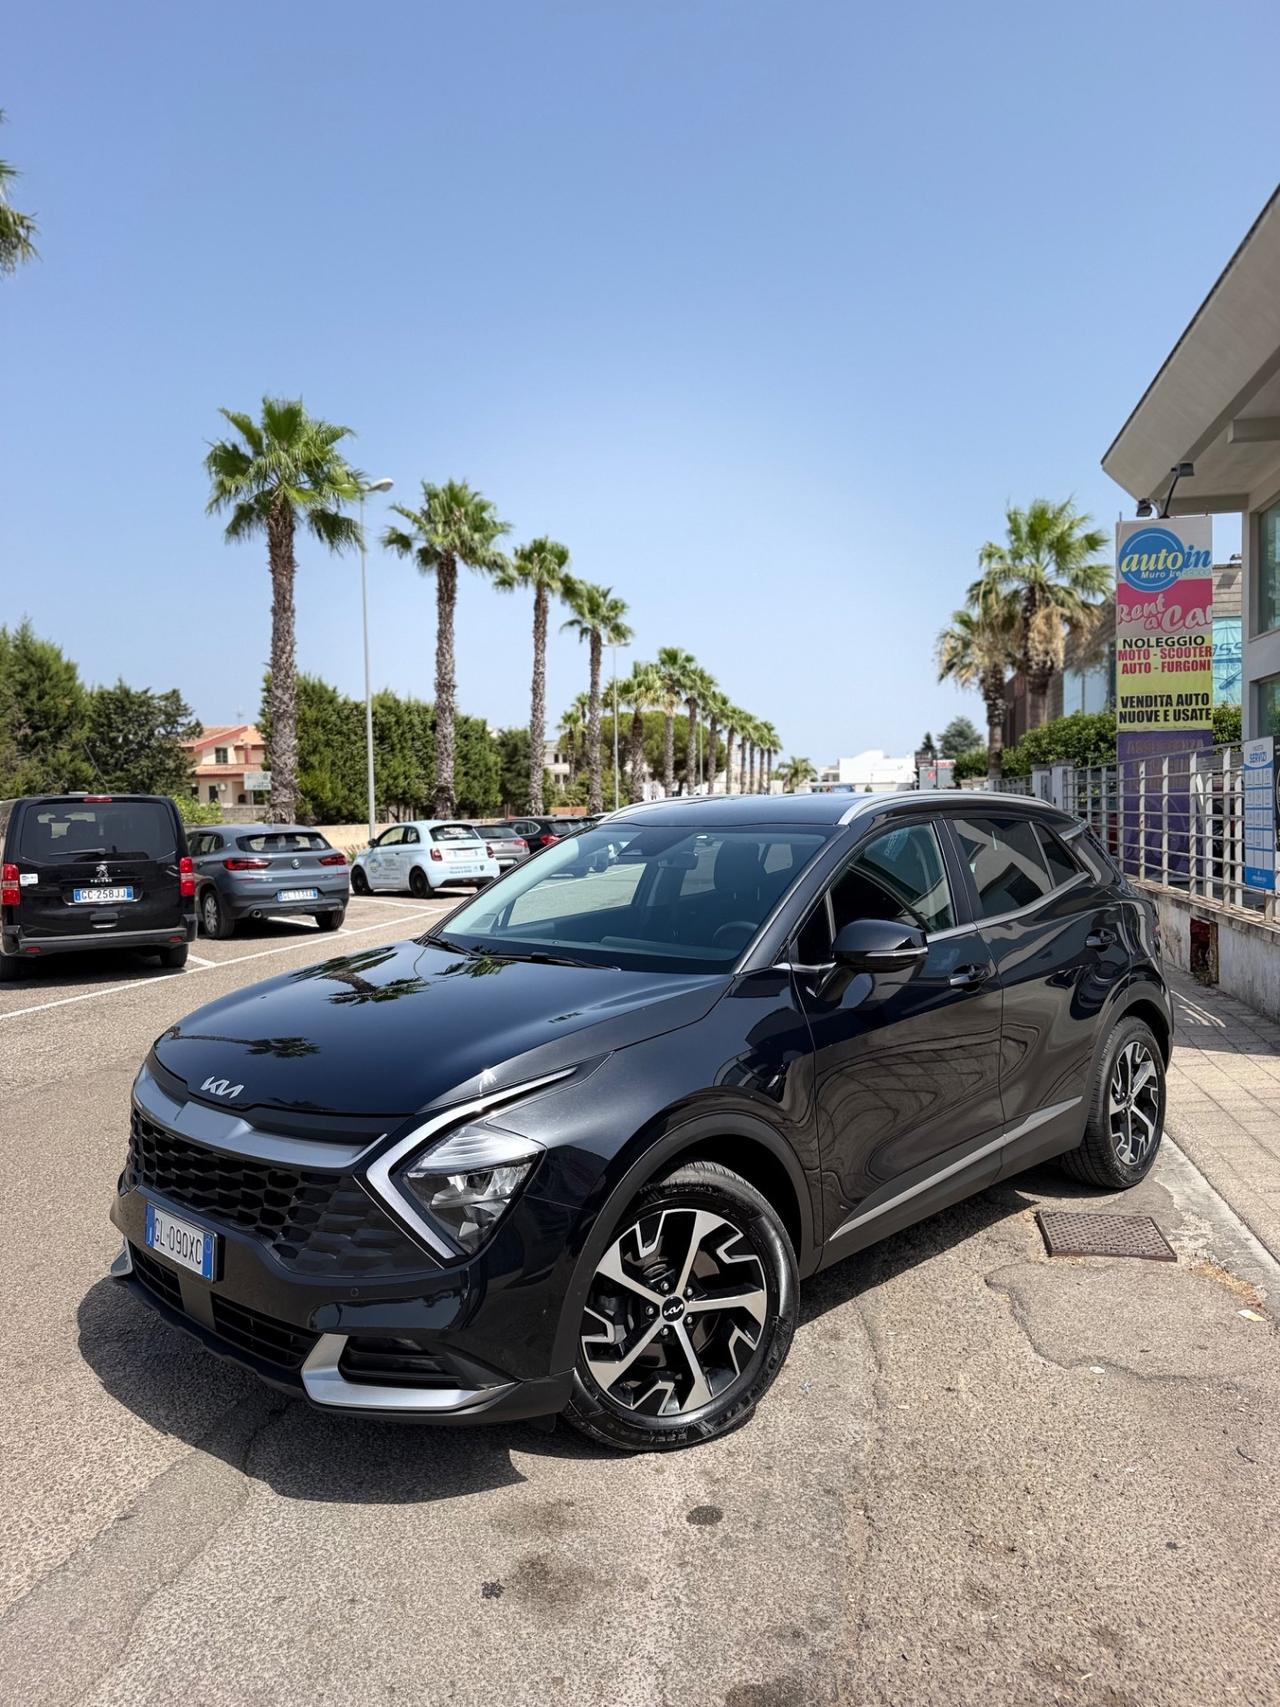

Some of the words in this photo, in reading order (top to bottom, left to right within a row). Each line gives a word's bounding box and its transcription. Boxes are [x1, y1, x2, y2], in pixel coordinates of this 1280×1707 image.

[1140, 571, 1166, 579] Muro
[1117, 593, 1167, 626] Rent
[1160, 603, 1213, 634] Car
[1122, 635, 1206, 649] NOLEGGIO
[1118, 648, 1151, 662] MOTO
[1160, 645, 1213, 660] SCOOTER
[1121, 661, 1152, 675] AUTO
[1160, 659, 1212, 674] FURGONI
[1120, 694, 1174, 709] VENDITA
[1176, 692, 1210, 707] AUTO
[1119, 708, 1161, 724] NUOVE
[1163, 708, 1170, 722] E
[1173, 707, 1212, 722] USATE
